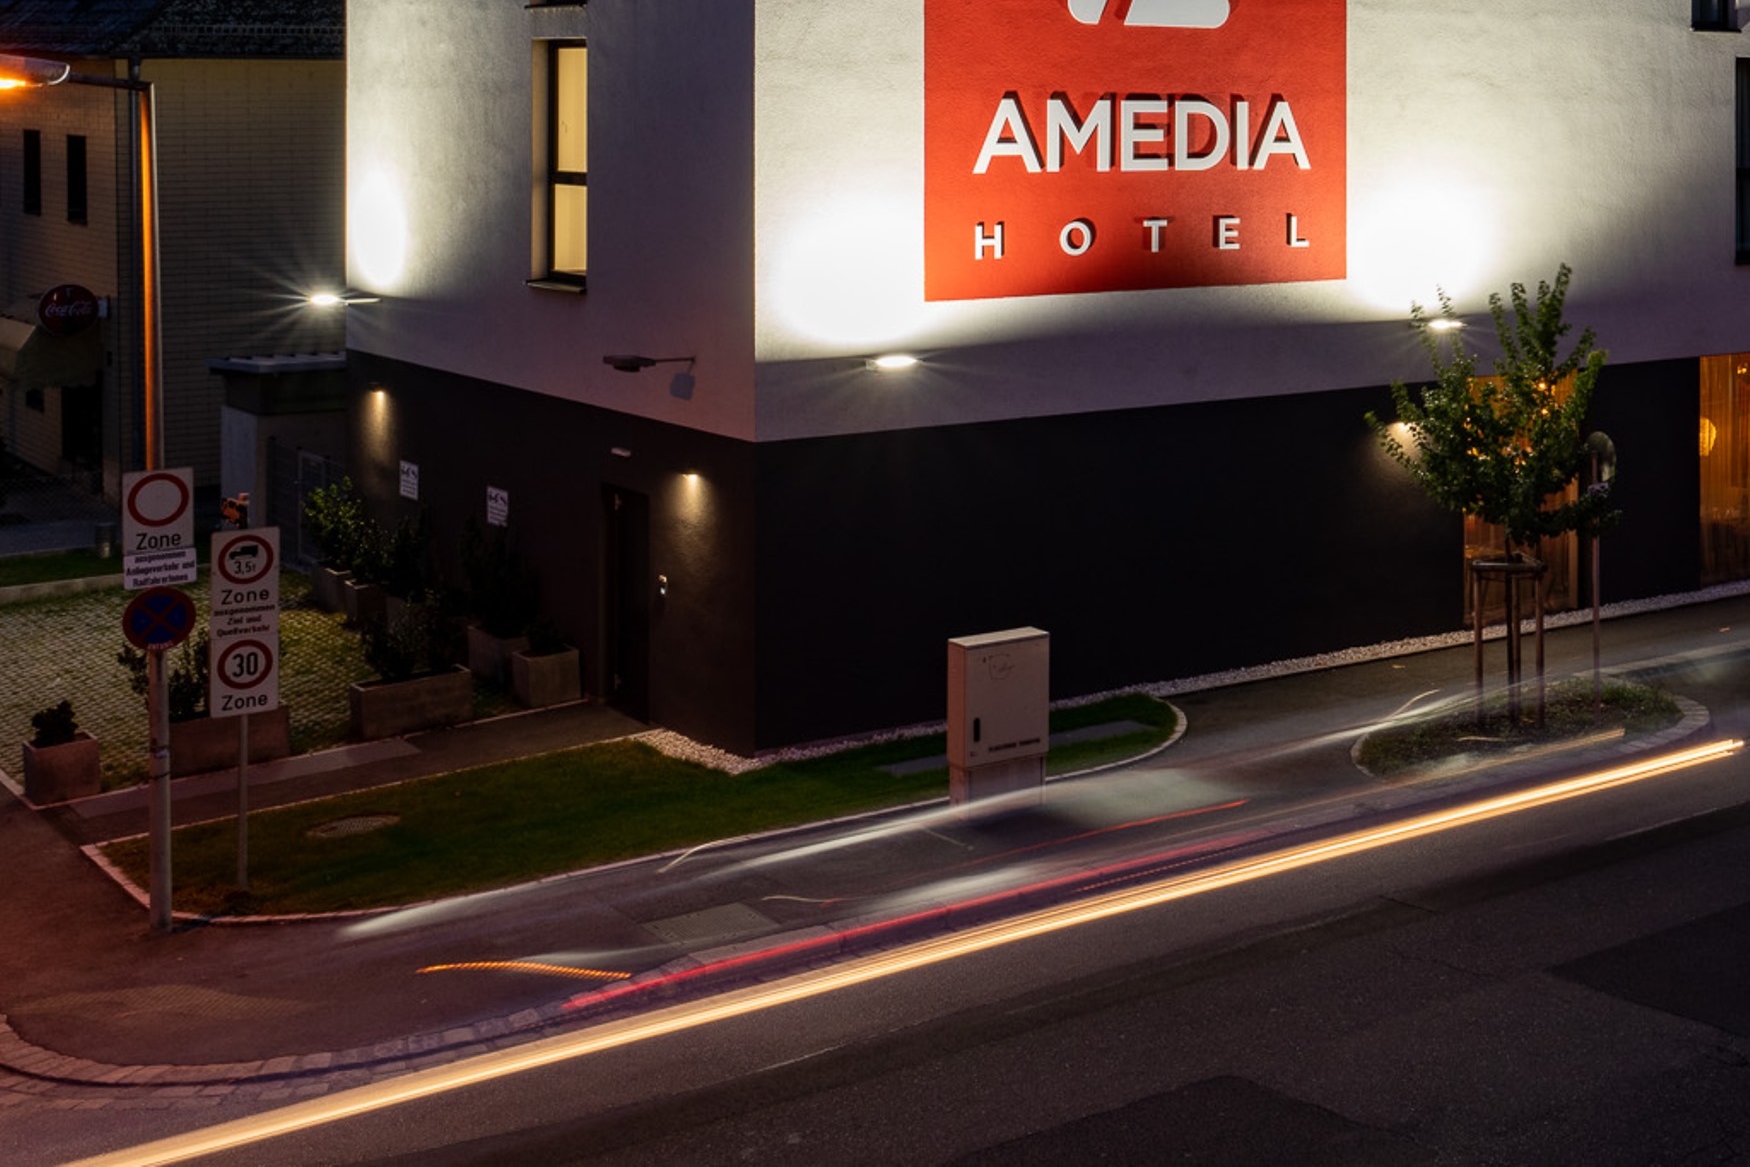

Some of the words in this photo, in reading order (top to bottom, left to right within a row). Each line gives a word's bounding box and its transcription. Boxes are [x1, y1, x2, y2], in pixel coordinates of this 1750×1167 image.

[973, 98, 1311, 174] AMEDIA
[973, 215, 1310, 260] HOTEL
[136, 533, 181, 550] Zone
[182, 559, 195, 570] und
[234, 560, 257, 575] 3,5t
[221, 589, 269, 605] Zone
[213, 604, 276, 617] ausgenommen
[227, 616, 244, 625] Ziel
[246, 614, 262, 623] und
[232, 652, 258, 677] 30
[221, 694, 268, 711] Zone
